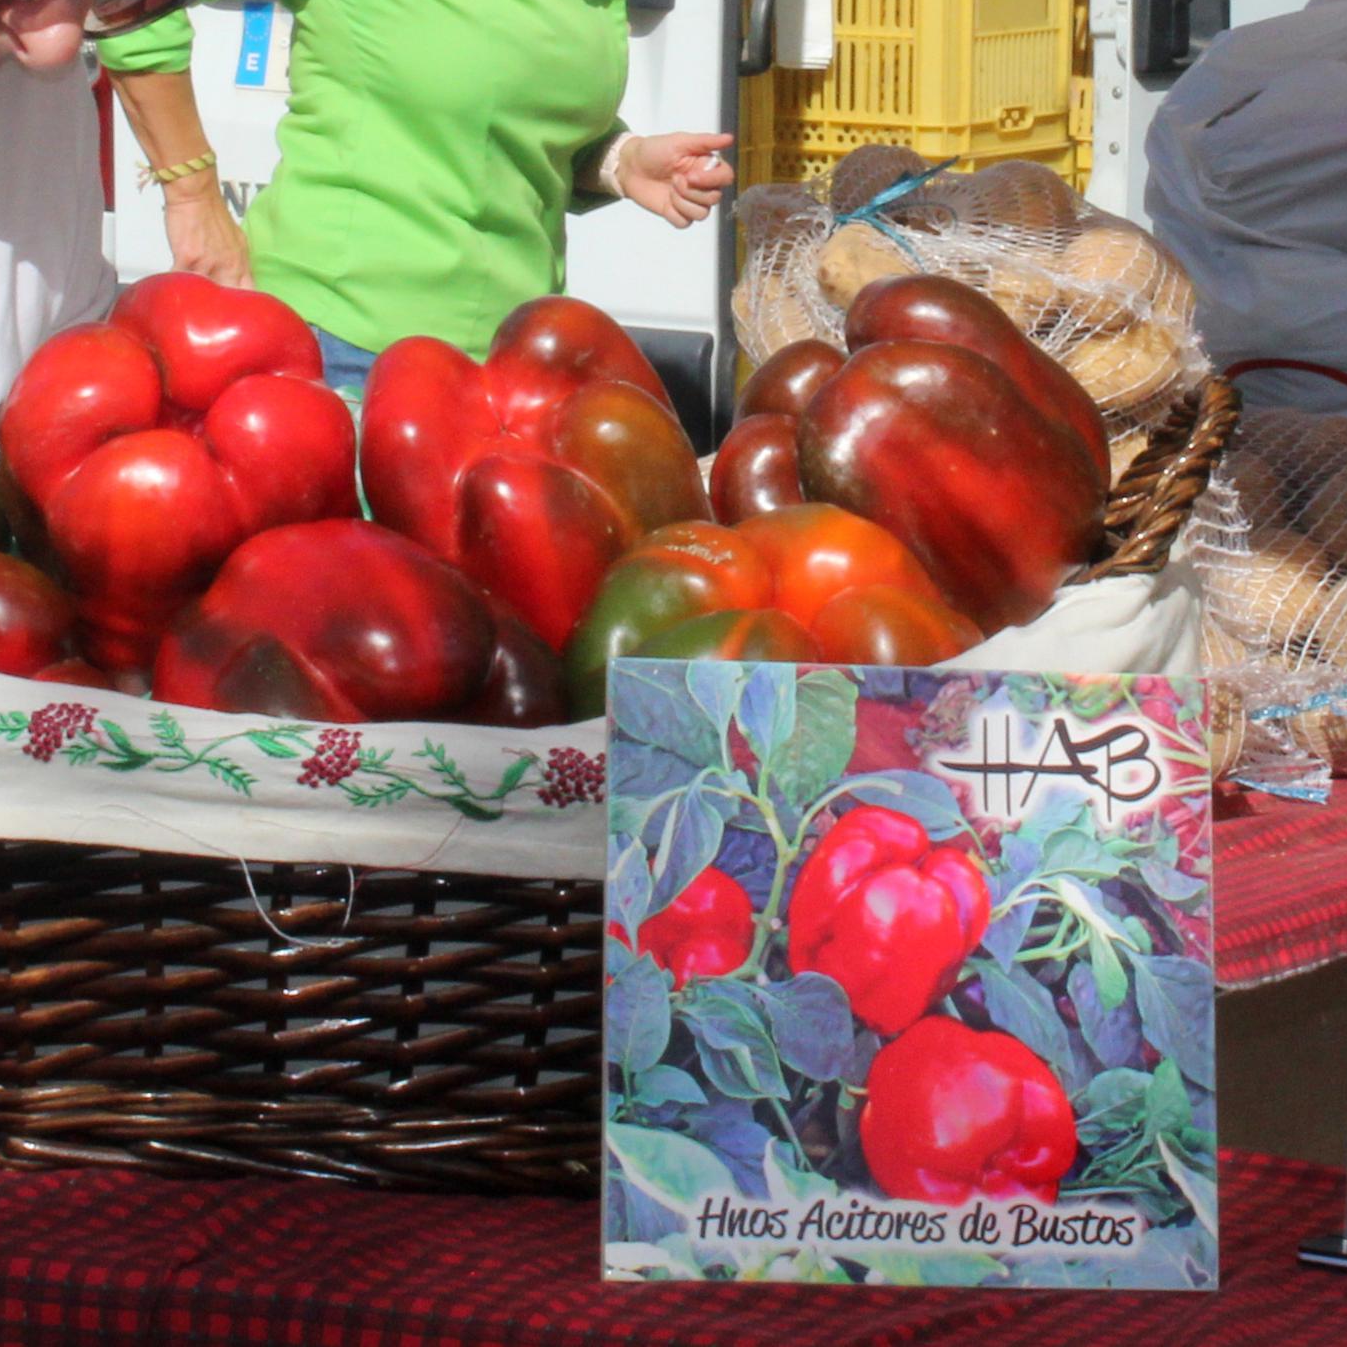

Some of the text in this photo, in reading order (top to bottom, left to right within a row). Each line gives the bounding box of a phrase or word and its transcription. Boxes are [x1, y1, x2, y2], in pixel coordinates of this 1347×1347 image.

[245, 52, 261, 72] E
[937, 714, 1162, 824] HAB
[697, 1198, 1136, 1249] Hnos Acitores de Bustos
